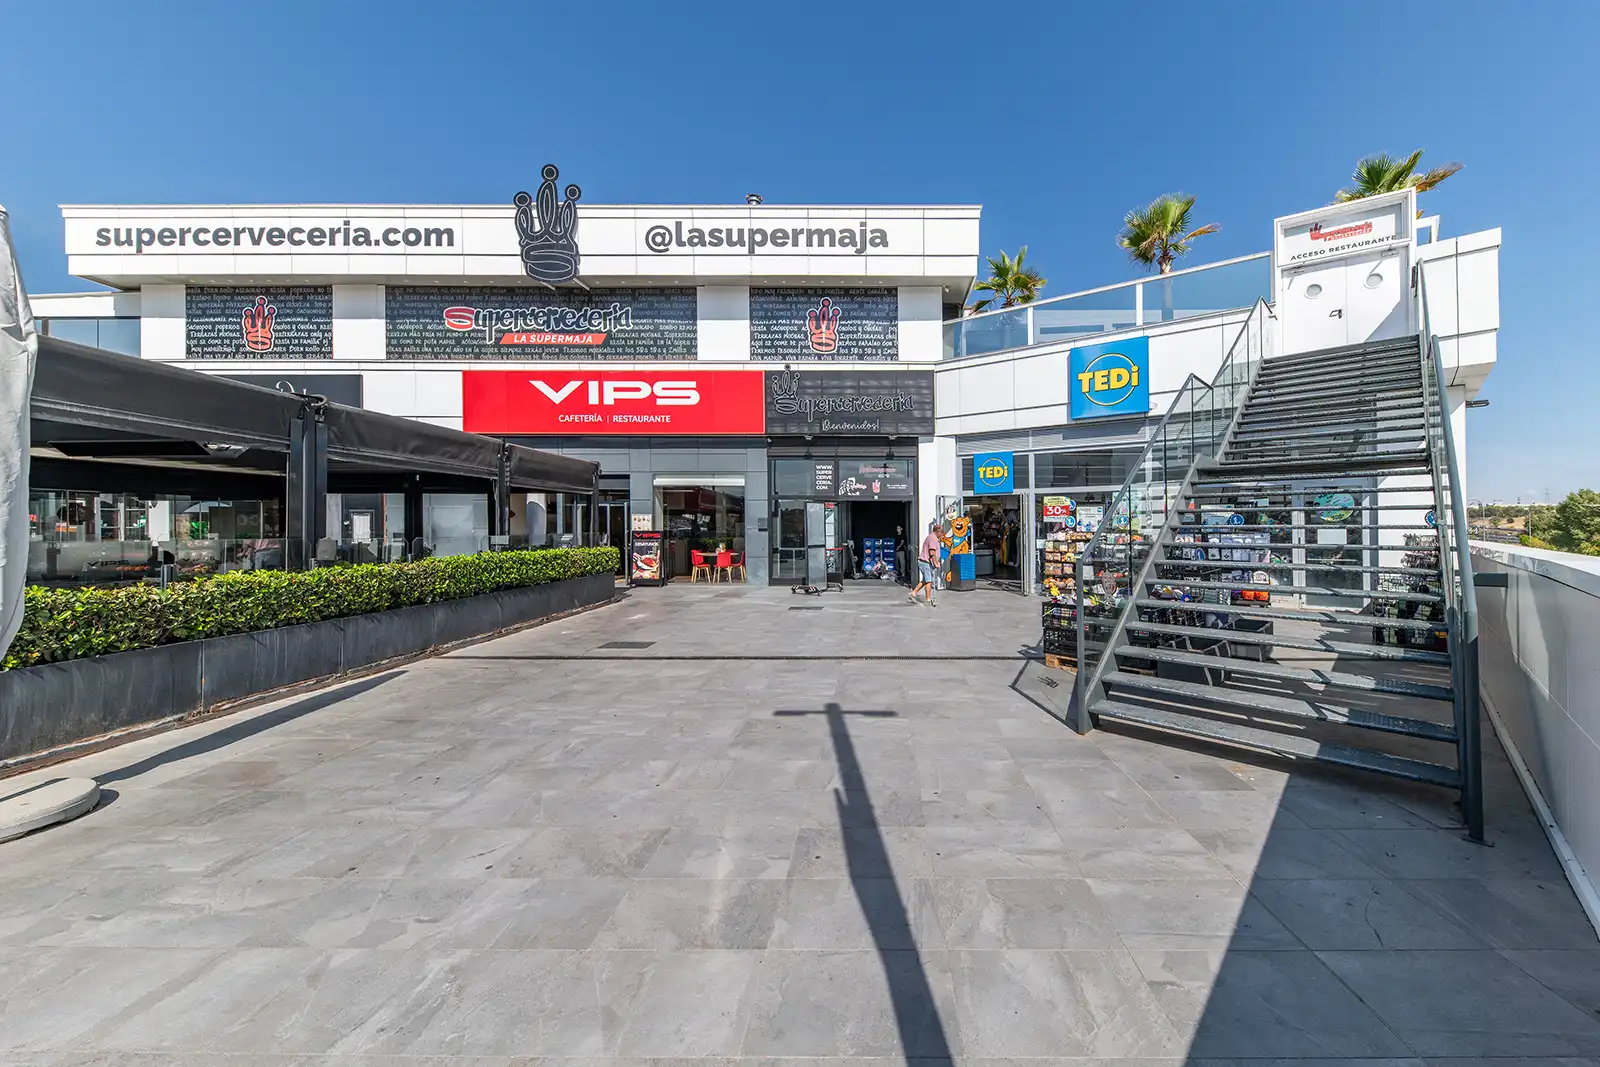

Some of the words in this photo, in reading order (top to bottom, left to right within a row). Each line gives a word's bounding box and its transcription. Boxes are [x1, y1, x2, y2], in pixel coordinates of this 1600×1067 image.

[95, 220, 455, 254] supercerveceria.com
[645, 221, 889, 254] @lasupermaja
[1290, 249, 1325, 261] ACCESO
[1329, 235, 1397, 253] RESTAURANTE
[513, 332, 528, 344] LA
[529, 332, 593, 344] SUPERMAJA
[1077, 365, 1140, 394] TEDi
[529, 380, 700, 405] VIPS
[558, 412, 603, 423] CAFETERÍA
[612, 415, 671, 423] RESTAURANTE
[977, 465, 1008, 479] TEDi
